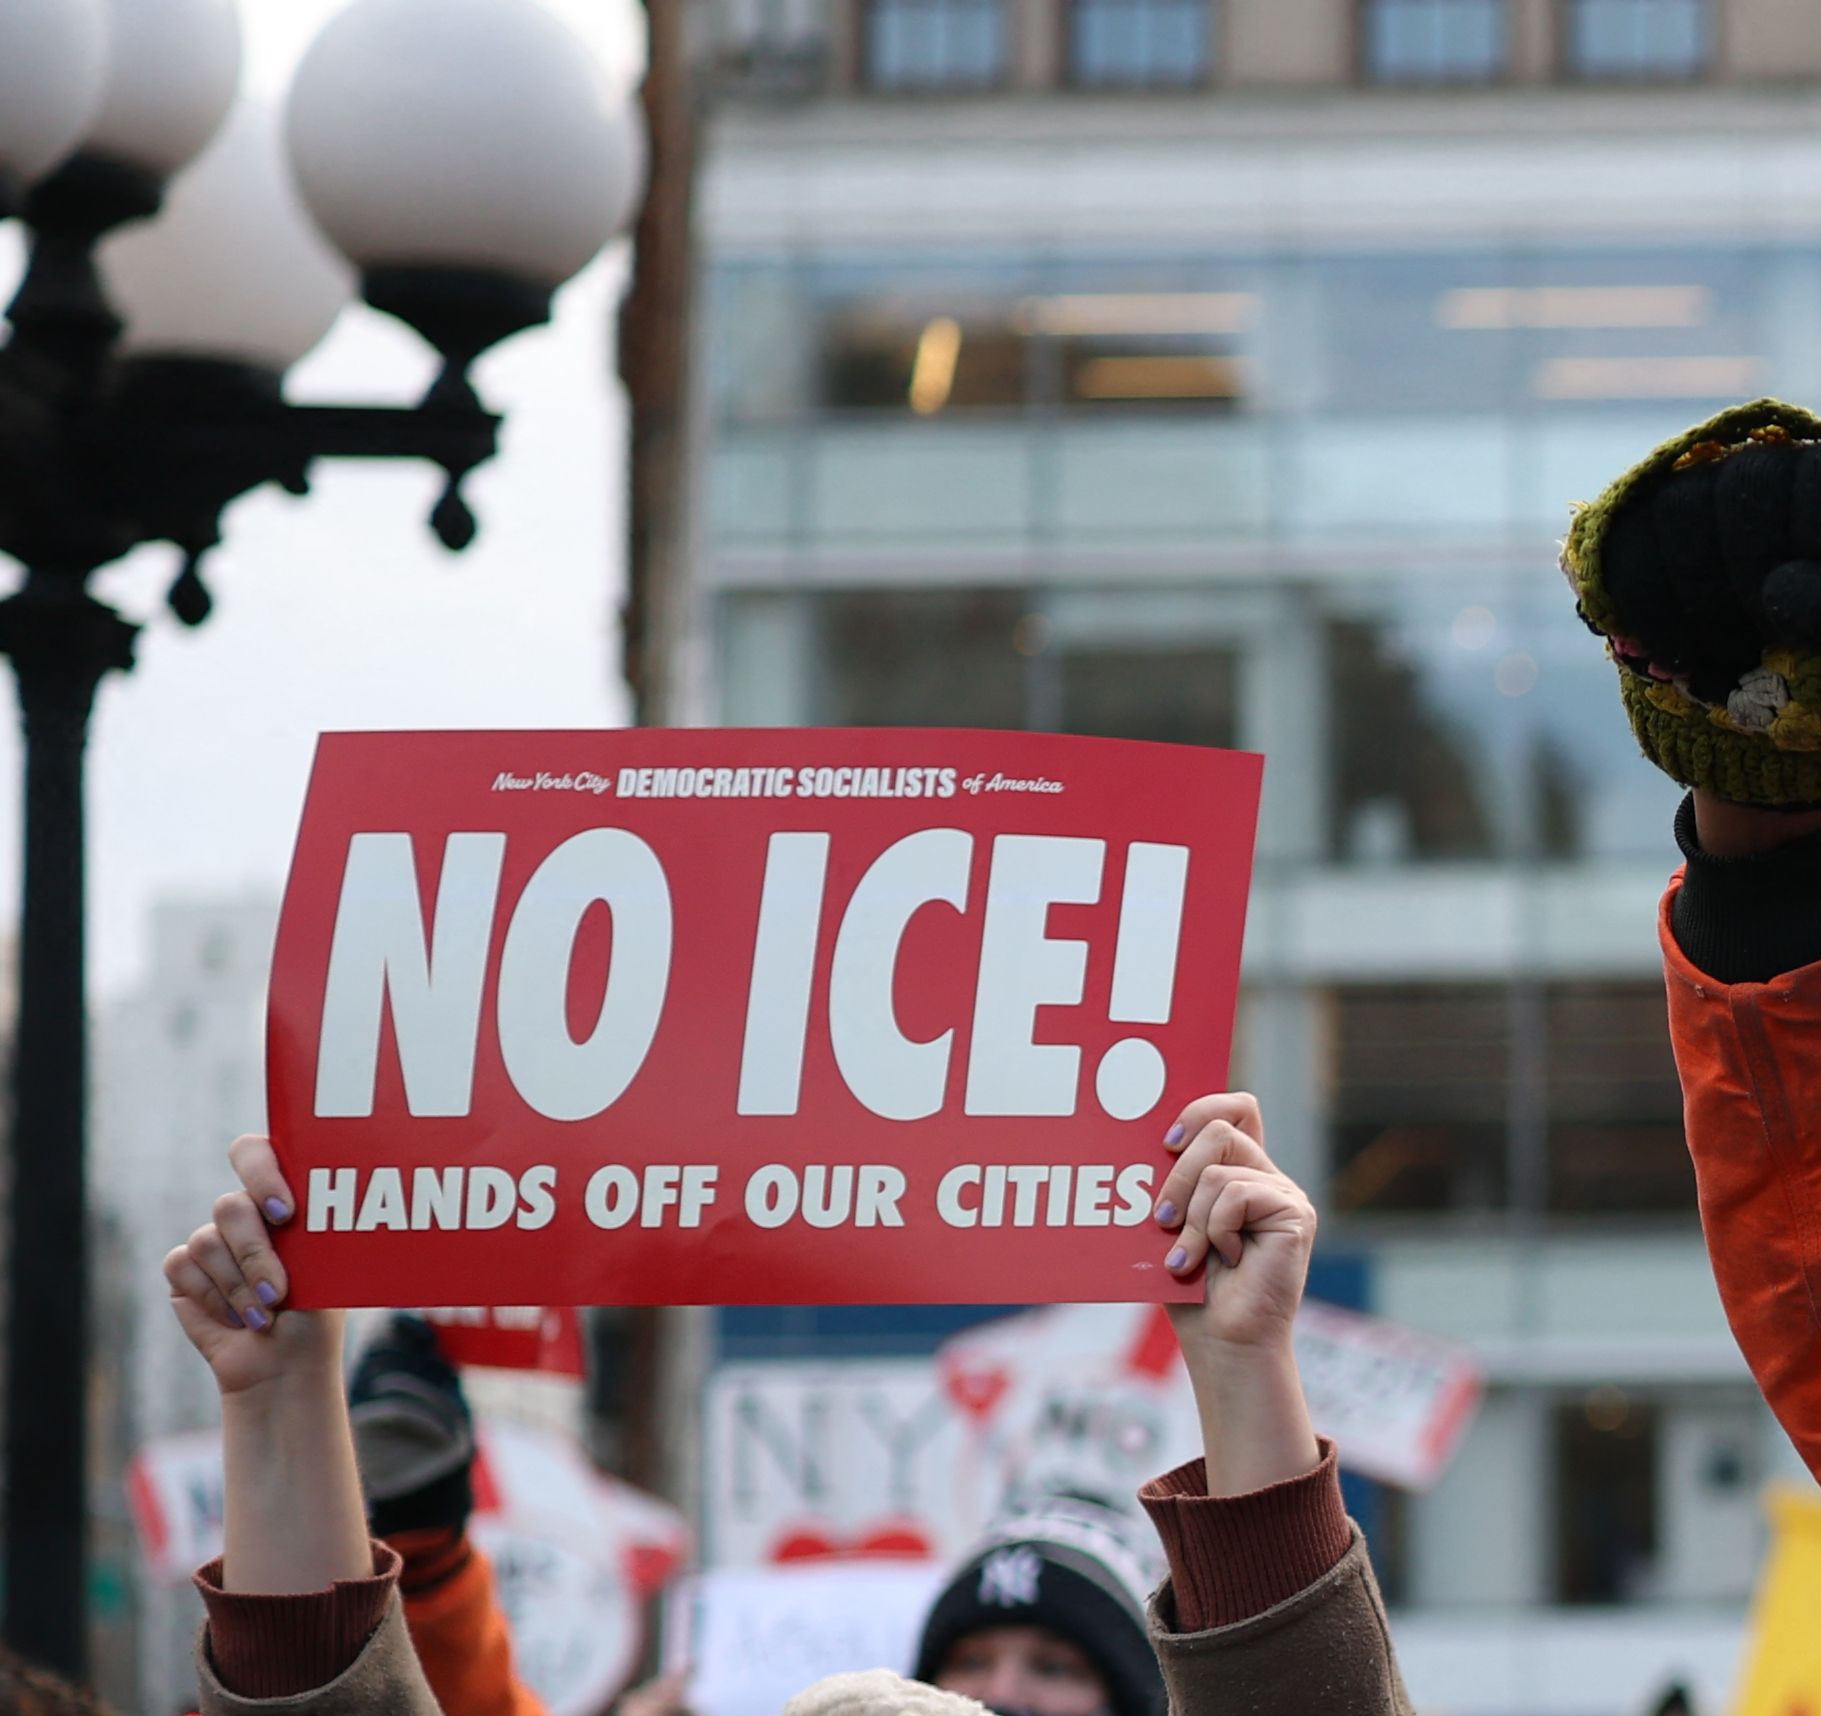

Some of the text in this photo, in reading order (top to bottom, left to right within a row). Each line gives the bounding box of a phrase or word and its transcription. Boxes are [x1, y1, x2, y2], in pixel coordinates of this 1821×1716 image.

[491, 766, 1065, 799] New York City DEMOCRATIC SOCIALISTS of America
[315, 828, 1189, 1121] NO ICE!
[307, 1163, 1155, 1231] HANDS OFF OUR CITIES
